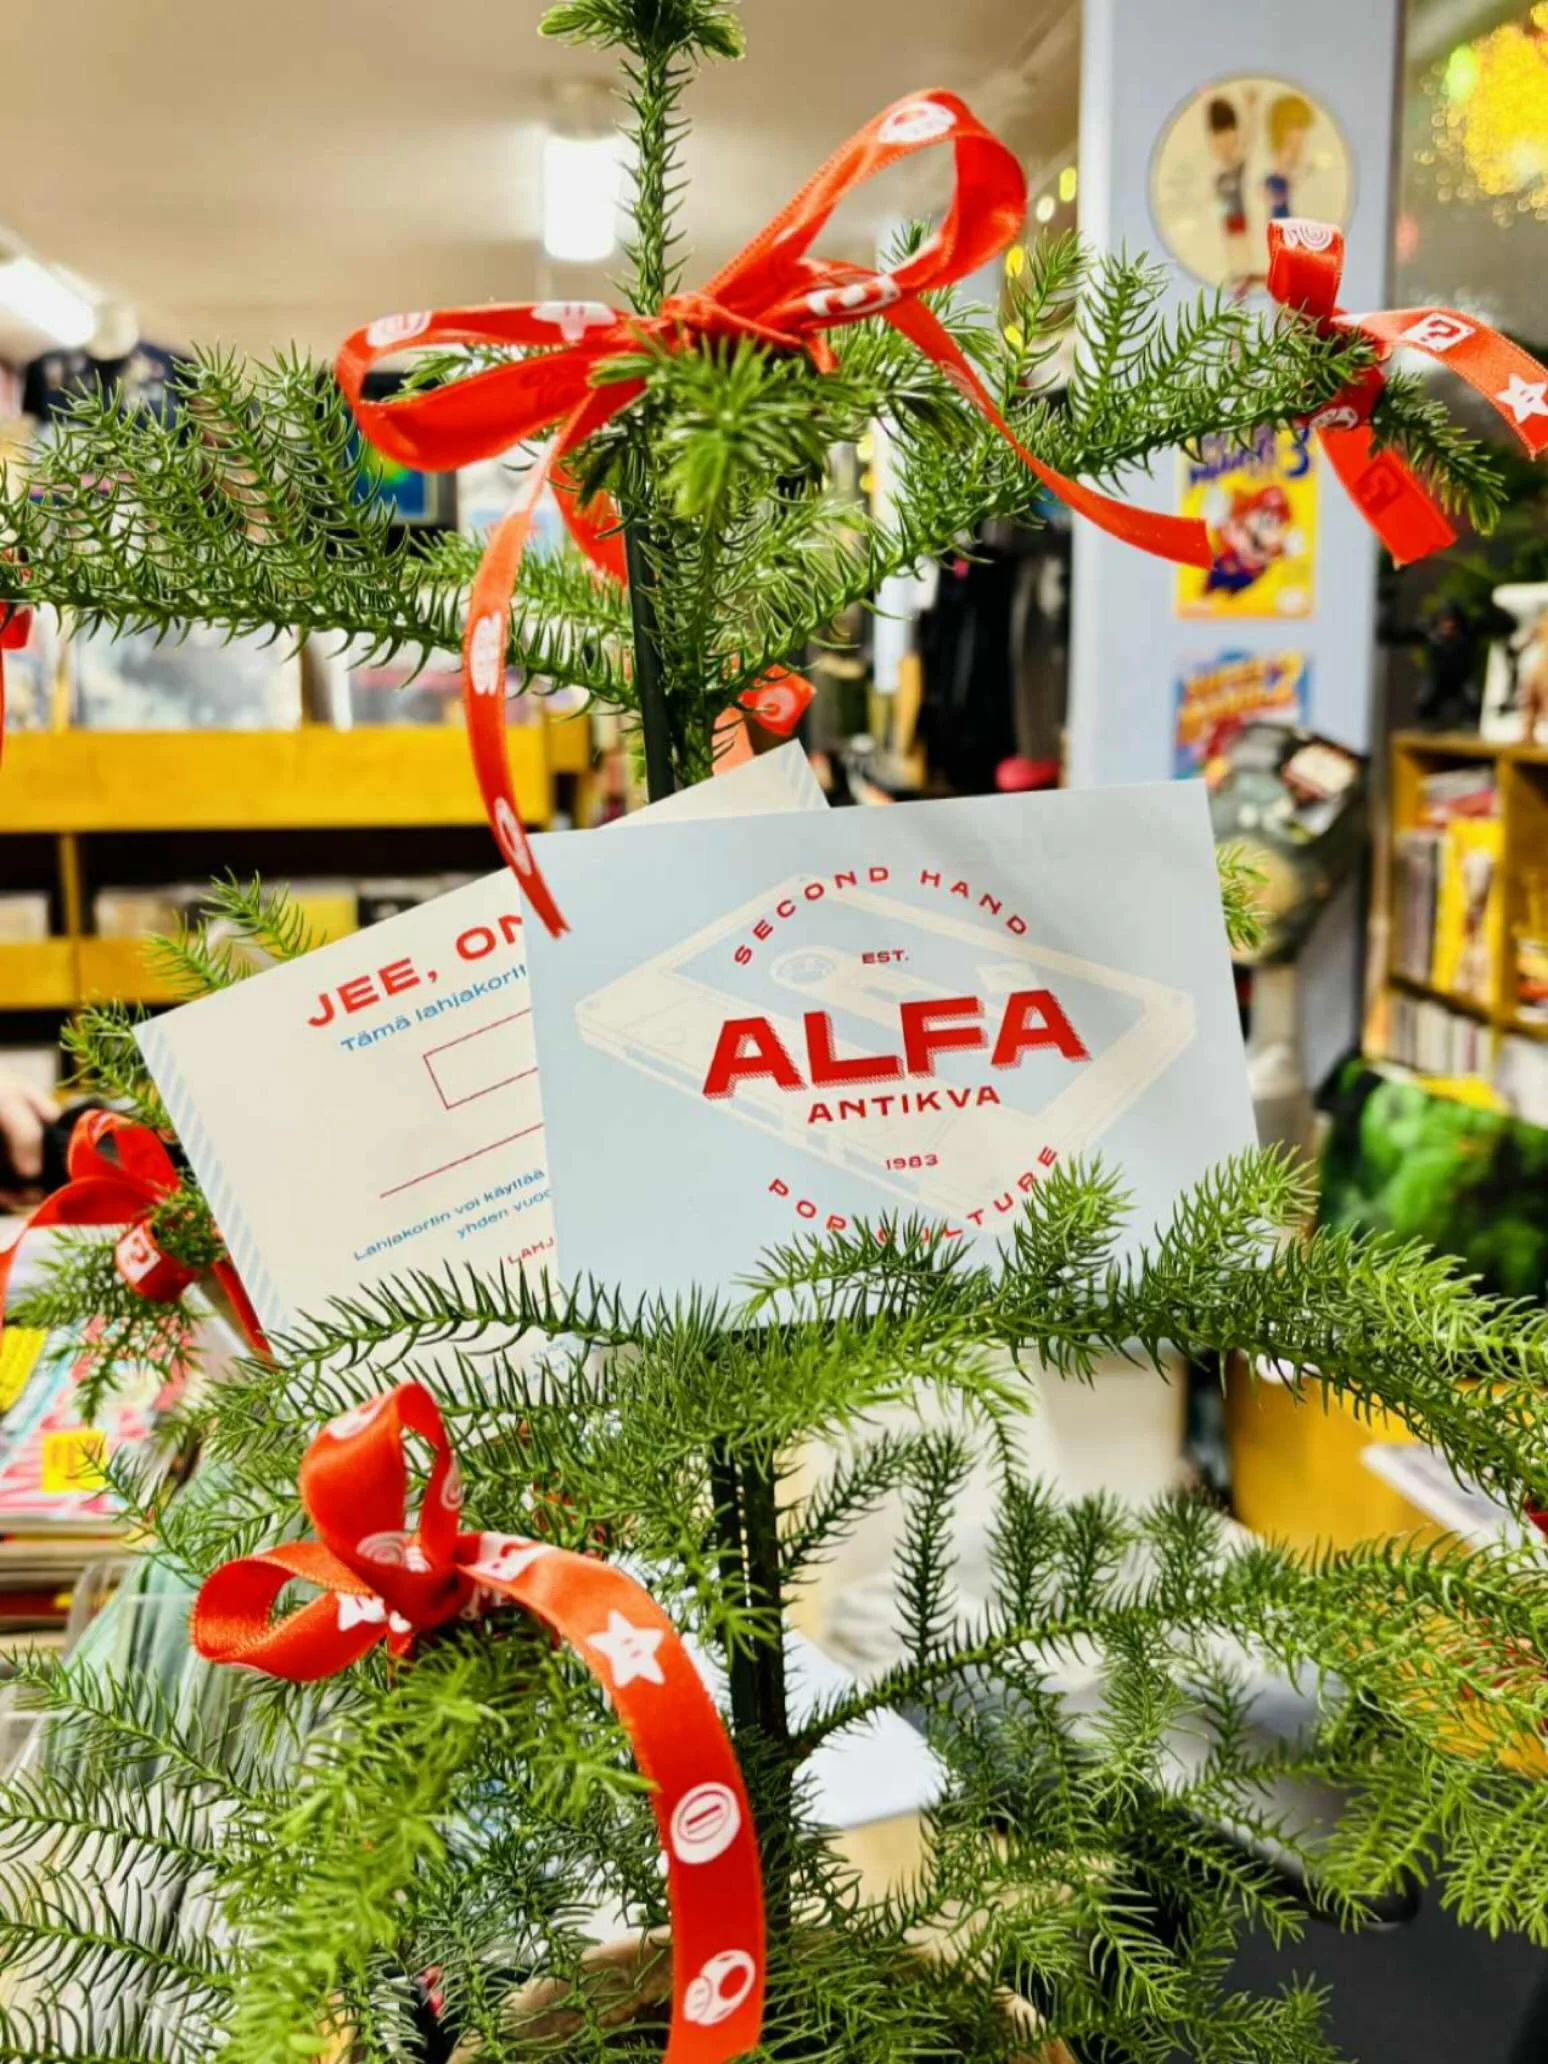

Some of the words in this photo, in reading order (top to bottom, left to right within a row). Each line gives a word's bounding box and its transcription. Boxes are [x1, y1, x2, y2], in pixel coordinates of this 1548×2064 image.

[733, 866, 889, 966] SECOND
[920, 869, 1027, 936] HAND
[862, 949, 909, 965] EST.
[307, 957, 439, 1028] JEE,
[341, 1015, 412, 1052] Tämä
[415, 963, 527, 1023] lahjakortt
[702, 989, 1092, 1101] ALFA
[807, 1085, 1001, 1124] ANTIKVA
[885, 1153, 940, 1171] 1983
[353, 1211, 451, 1262] Lahjakortin
[454, 1198, 480, 1215] voi
[456, 1209, 509, 1241] yhden
[768, 1178, 848, 1232] POP
[507, 1236, 555, 1265] LAHJ
